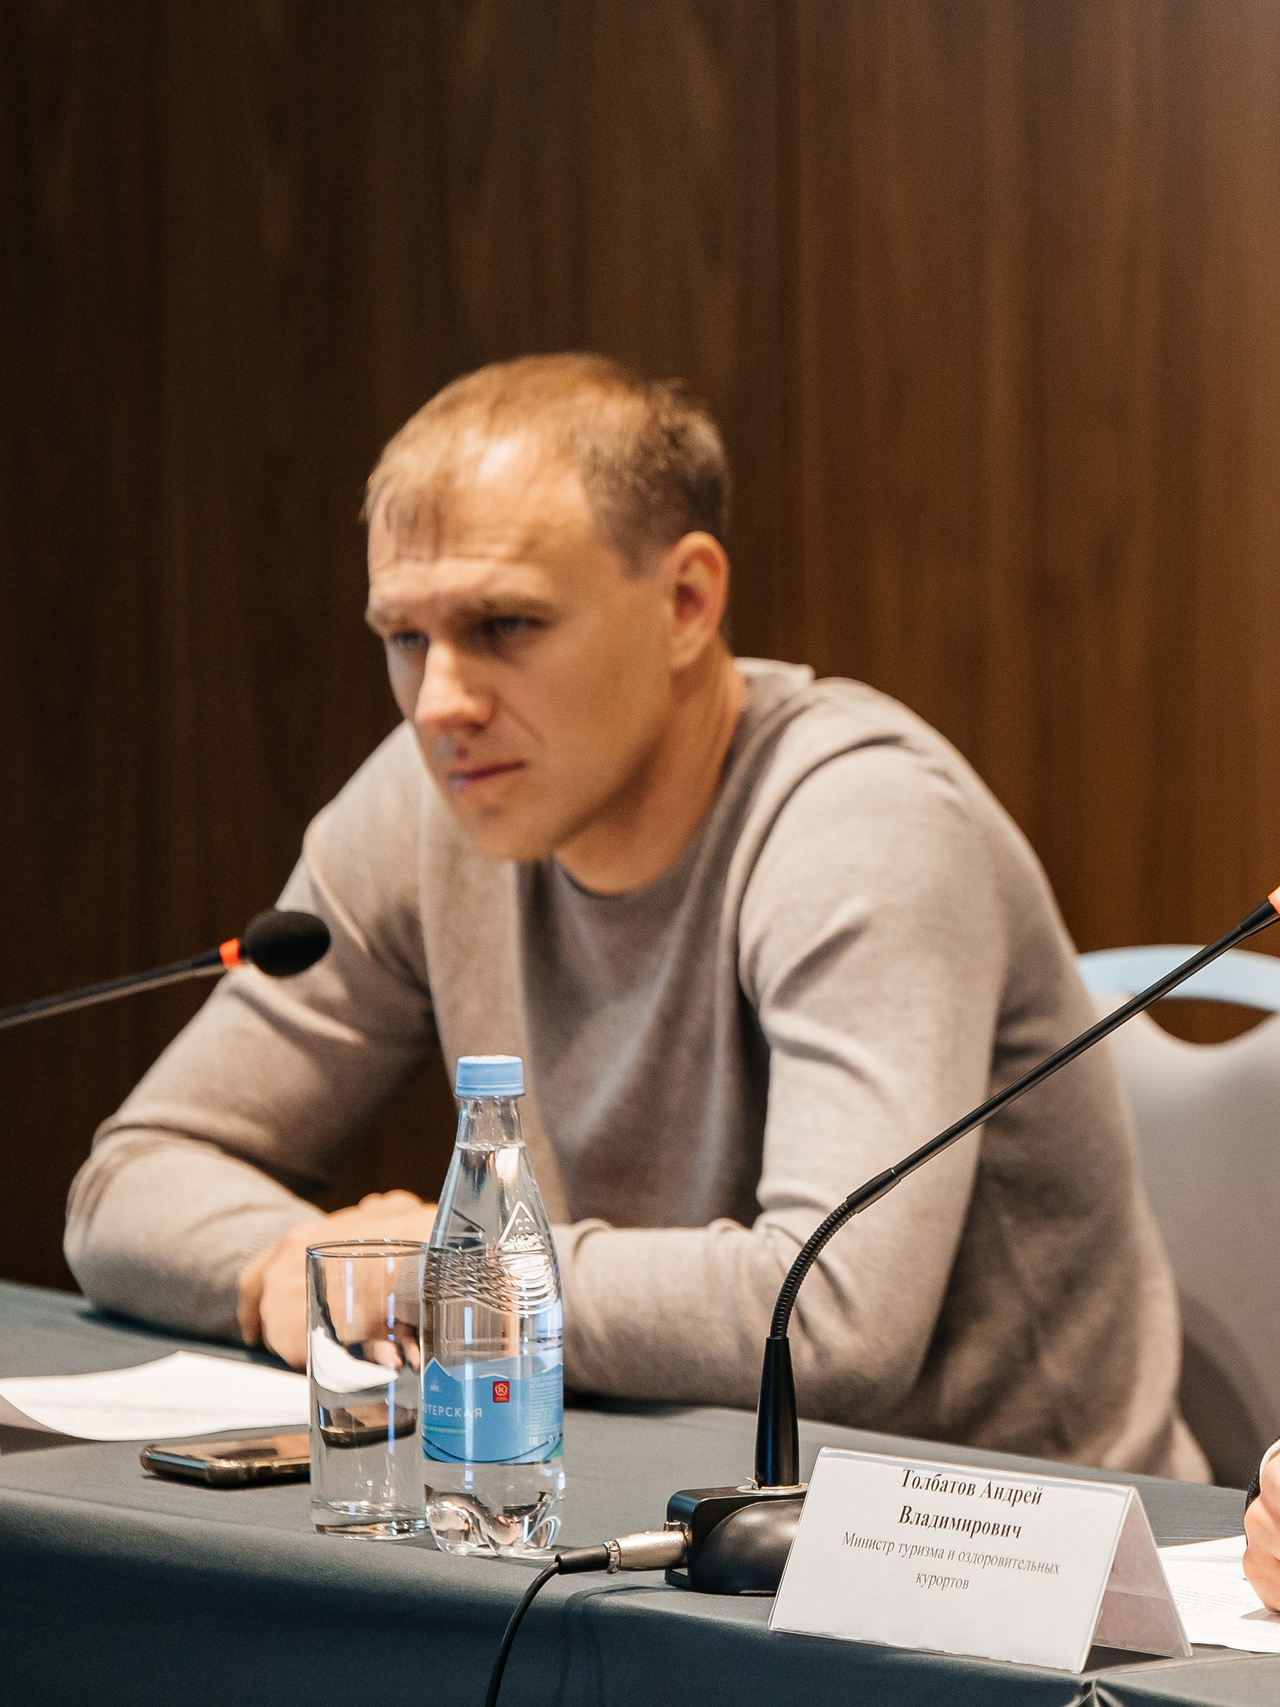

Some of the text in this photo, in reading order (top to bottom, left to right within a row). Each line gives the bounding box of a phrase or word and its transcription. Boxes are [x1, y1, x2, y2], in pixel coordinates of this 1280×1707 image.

[901, 1469, 1043, 1507] Толбатов Андрей
[898, 1505, 1022, 1539] Владимирович
[842, 1531, 1061, 1575] Министр туризма и оздоровительных
[915, 1571, 970, 1591] курортов
